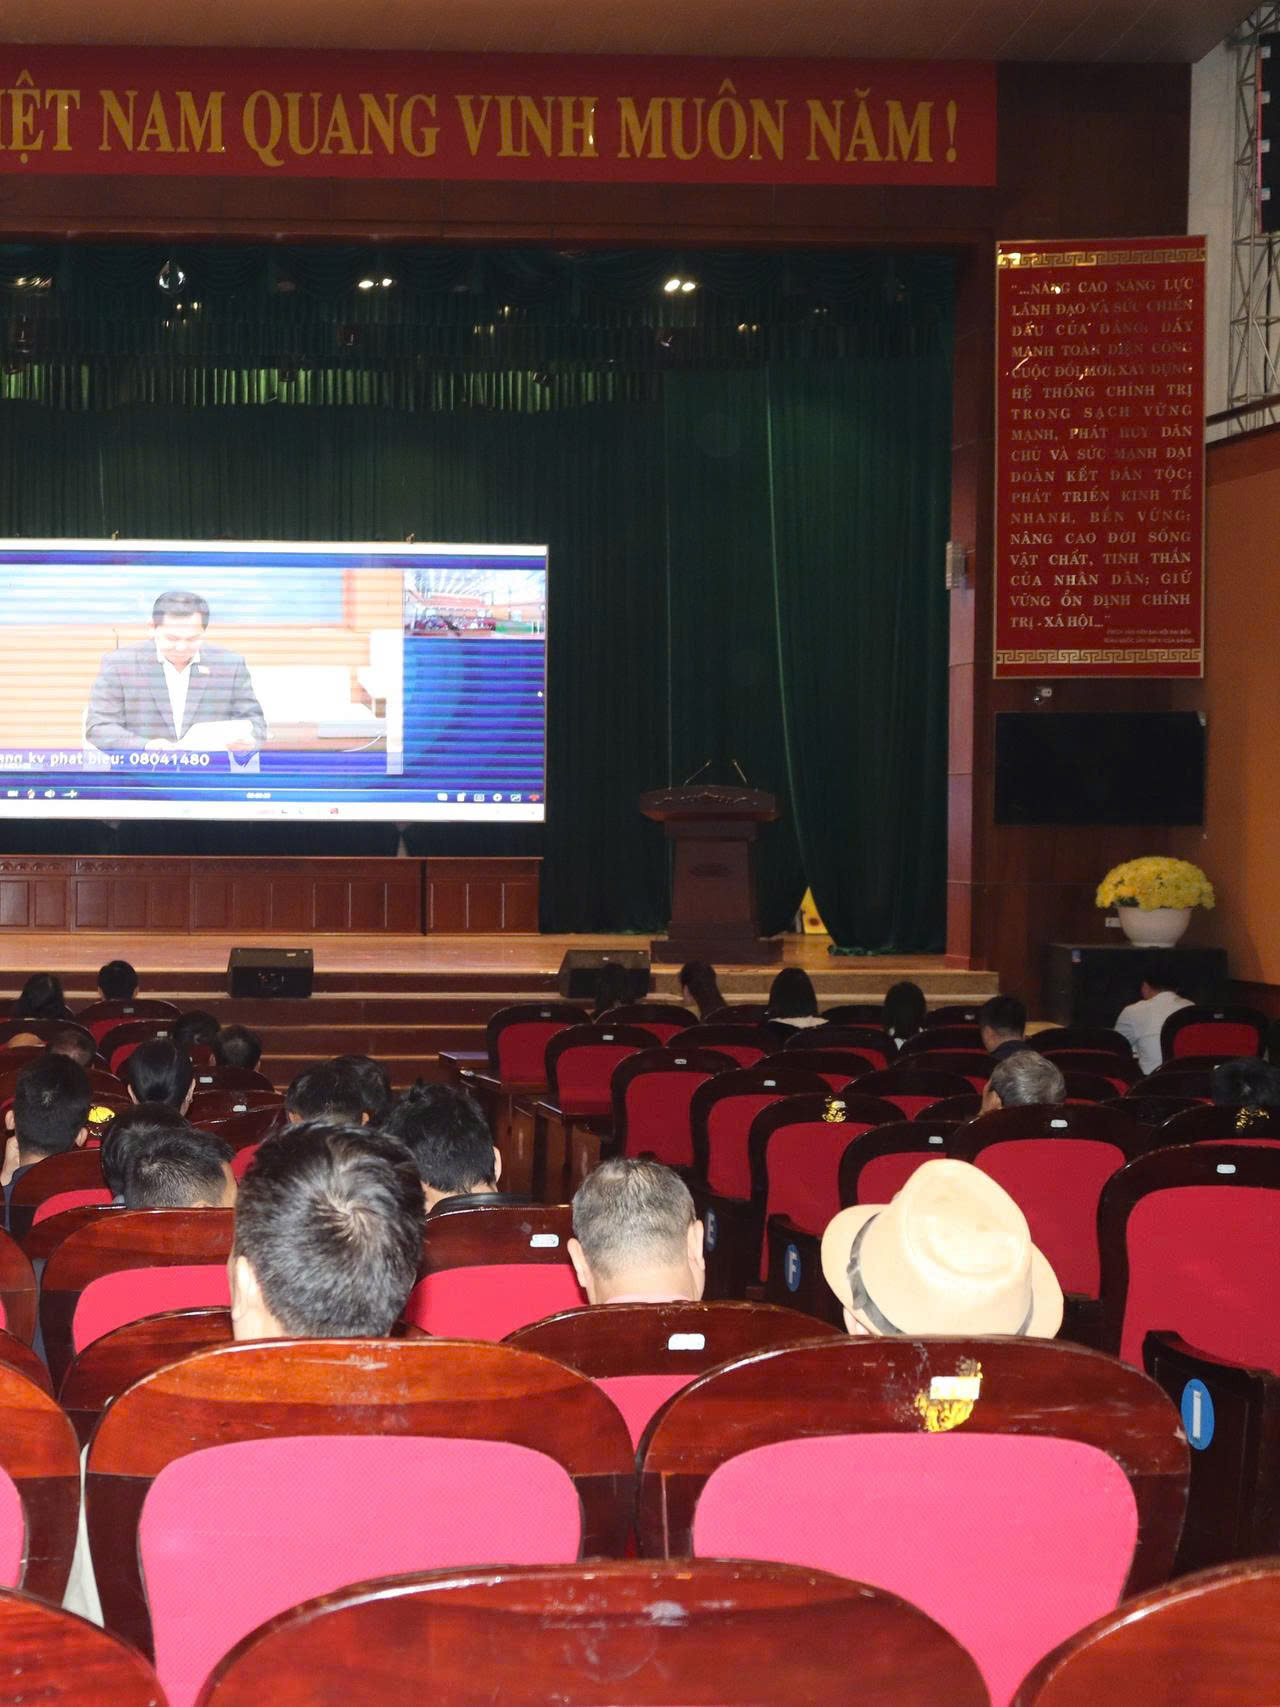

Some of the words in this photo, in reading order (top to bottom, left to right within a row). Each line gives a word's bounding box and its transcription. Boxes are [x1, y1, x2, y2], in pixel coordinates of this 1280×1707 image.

[99, 86, 226, 153] NAM
[242, 90, 440, 167] QUANG
[456, 93, 598, 158] VINH
[617, 76, 786, 161] MUÔN
[1078, 282, 1108, 293] CAO
[1056, 303, 1085, 317] ĐẠO
[1107, 384, 1155, 397] CHÍNH
[1167, 385, 1192, 398] TRỊ
[1011, 408, 1071, 420] TRONG
[1084, 405, 1131, 420] SẠCH
[1049, 445, 1068, 461] VÀ
[1121, 490, 1160, 502] KINH
[1010, 531, 1053, 545] NÂNG
[1065, 532, 1096, 544] CAO
[1010, 551, 1038, 567] VẬT
[1103, 552, 1138, 565] TINH
[1093, 594, 1130, 608] ĐỊNH
[129, 752, 211, 766] 08041480
[788, 1251, 798, 1284] F
